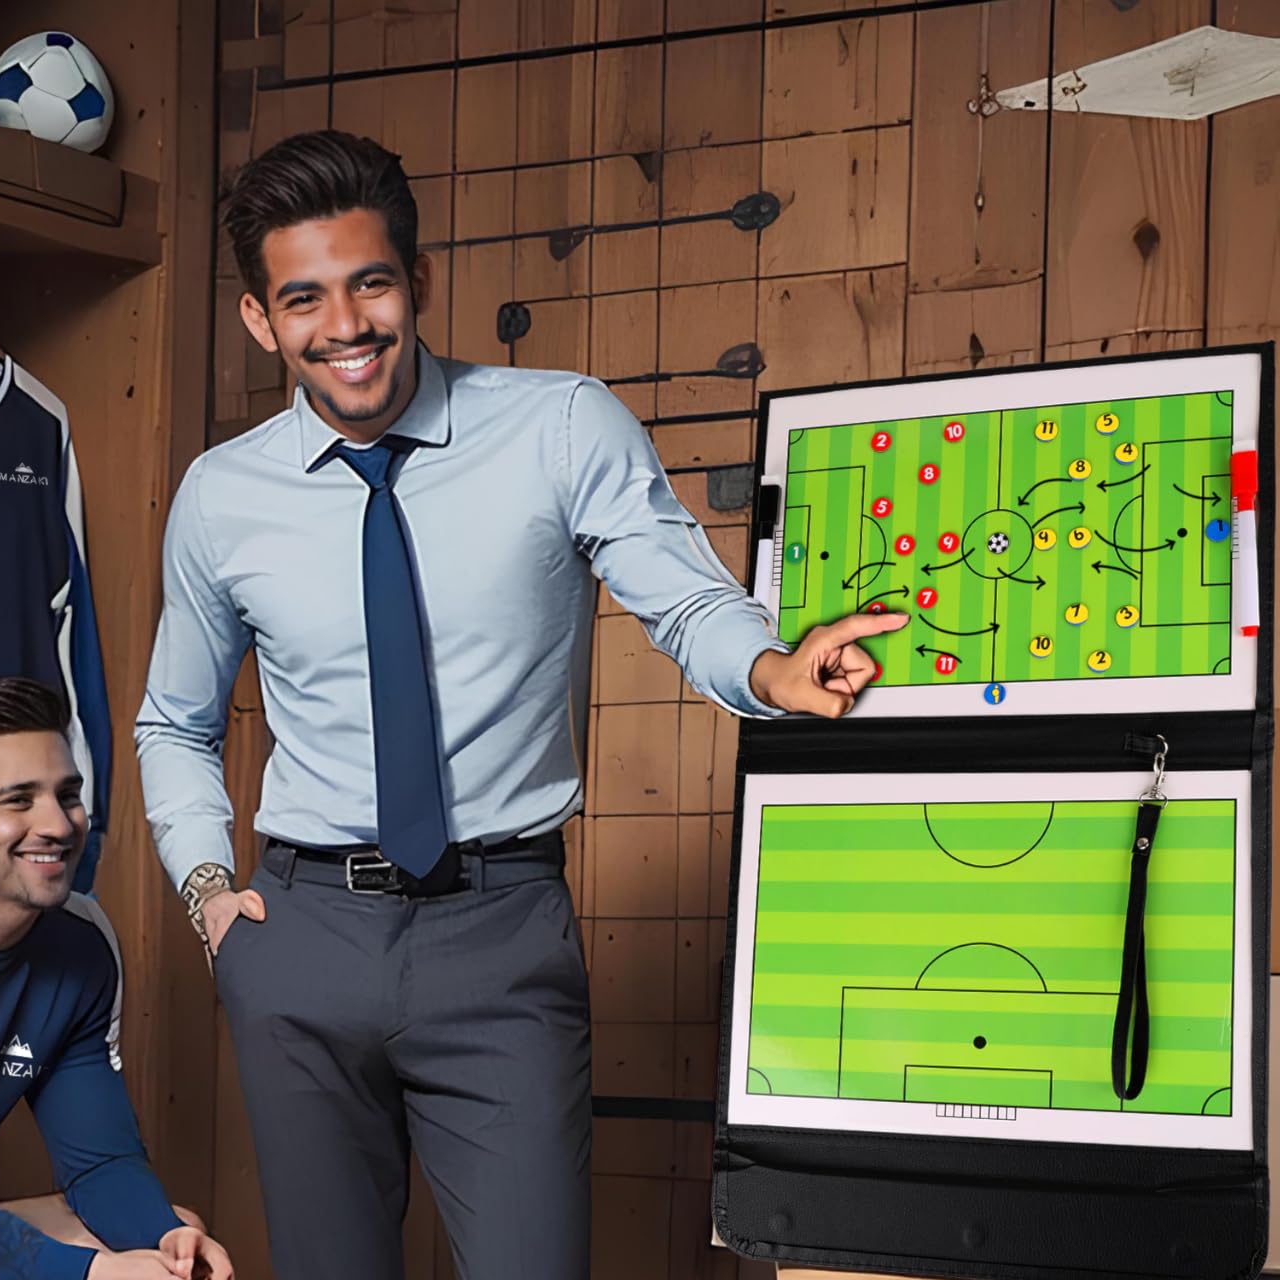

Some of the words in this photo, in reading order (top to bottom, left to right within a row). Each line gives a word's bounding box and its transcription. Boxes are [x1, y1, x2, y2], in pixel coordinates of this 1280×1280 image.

[1103, 414, 1113, 427] 5
[947, 424, 963, 439] 10
[1042, 422, 1054, 435] 11
[875, 434, 887, 447] 2
[1122, 443, 1133, 456] 4
[1076, 460, 1086, 473] 8
[0, 472, 49, 486] MANZAKI
[924, 467, 934, 480] 8
[876, 500, 888, 514] 5
[943, 536, 954, 549] 9
[1038, 531, 1049, 543] 9
[1074, 530, 1084, 542] 6
[900, 538, 910, 551] 6
[922, 592, 933, 605] 7
[1070, 604, 1081, 617] 7
[1120, 607, 1133, 620] 3
[1035, 637, 1051, 650] 10
[940, 657, 953, 671] 11
[1096, 651, 1107, 665] 2
